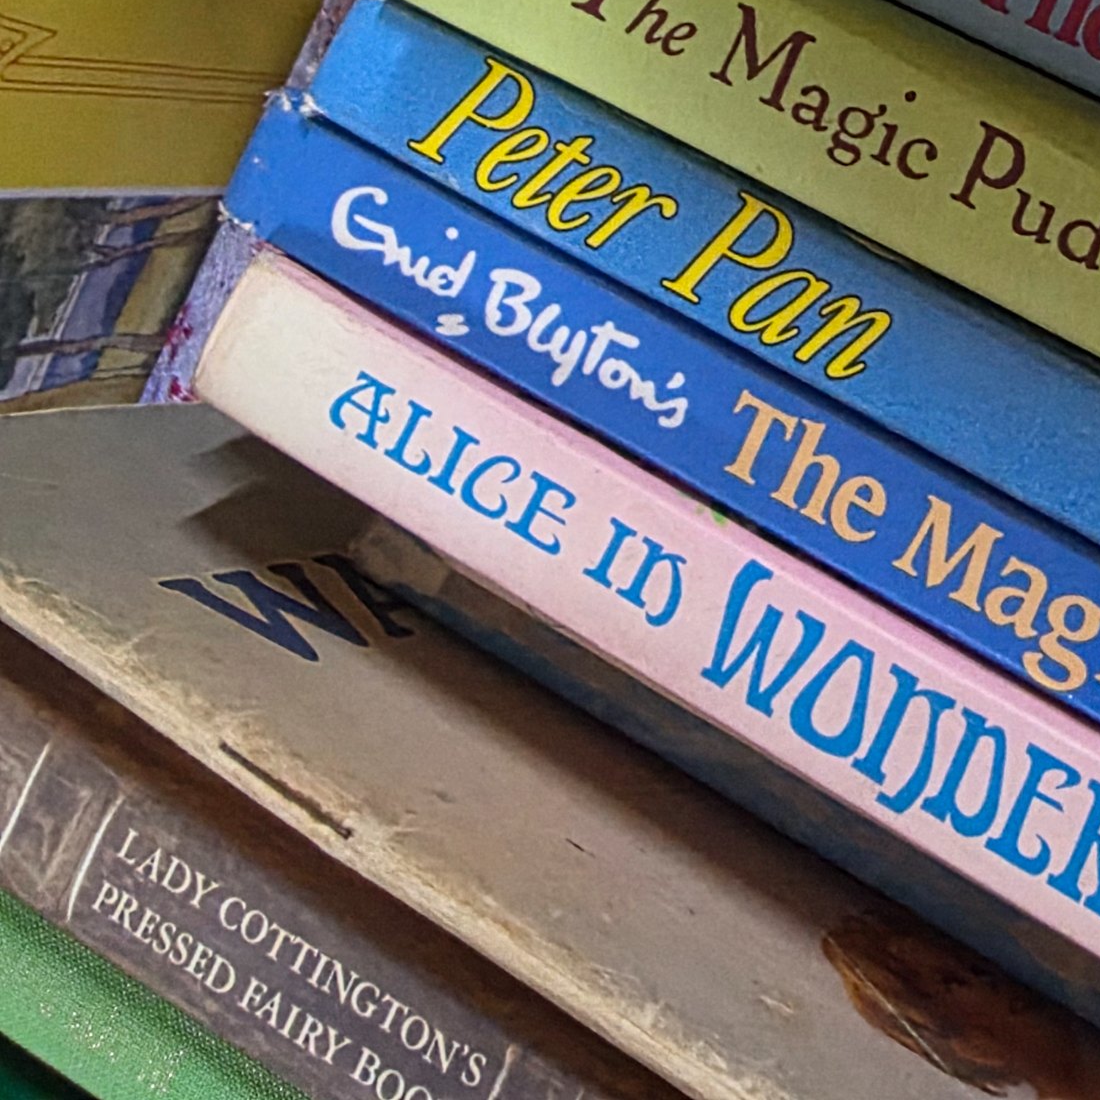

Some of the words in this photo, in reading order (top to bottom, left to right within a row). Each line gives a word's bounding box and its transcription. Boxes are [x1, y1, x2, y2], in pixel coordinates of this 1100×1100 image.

[709, 2, 939, 181] Magic
[331, 185, 477, 300] Enid
[483, 266, 689, 430] Blyton's
[407, 55, 679, 250] Peter
[661, 189, 894, 381] Pan
[327, 370, 577, 556] ALICE
[581, 516, 689, 628] IN
[722, 389, 887, 543] The
[92, 880, 237, 995] PRESSED
[236, 976, 352, 1067] FAIRY
[116, 828, 222, 912] LADY
[218, 895, 489, 1088] COTTINGTON'S
